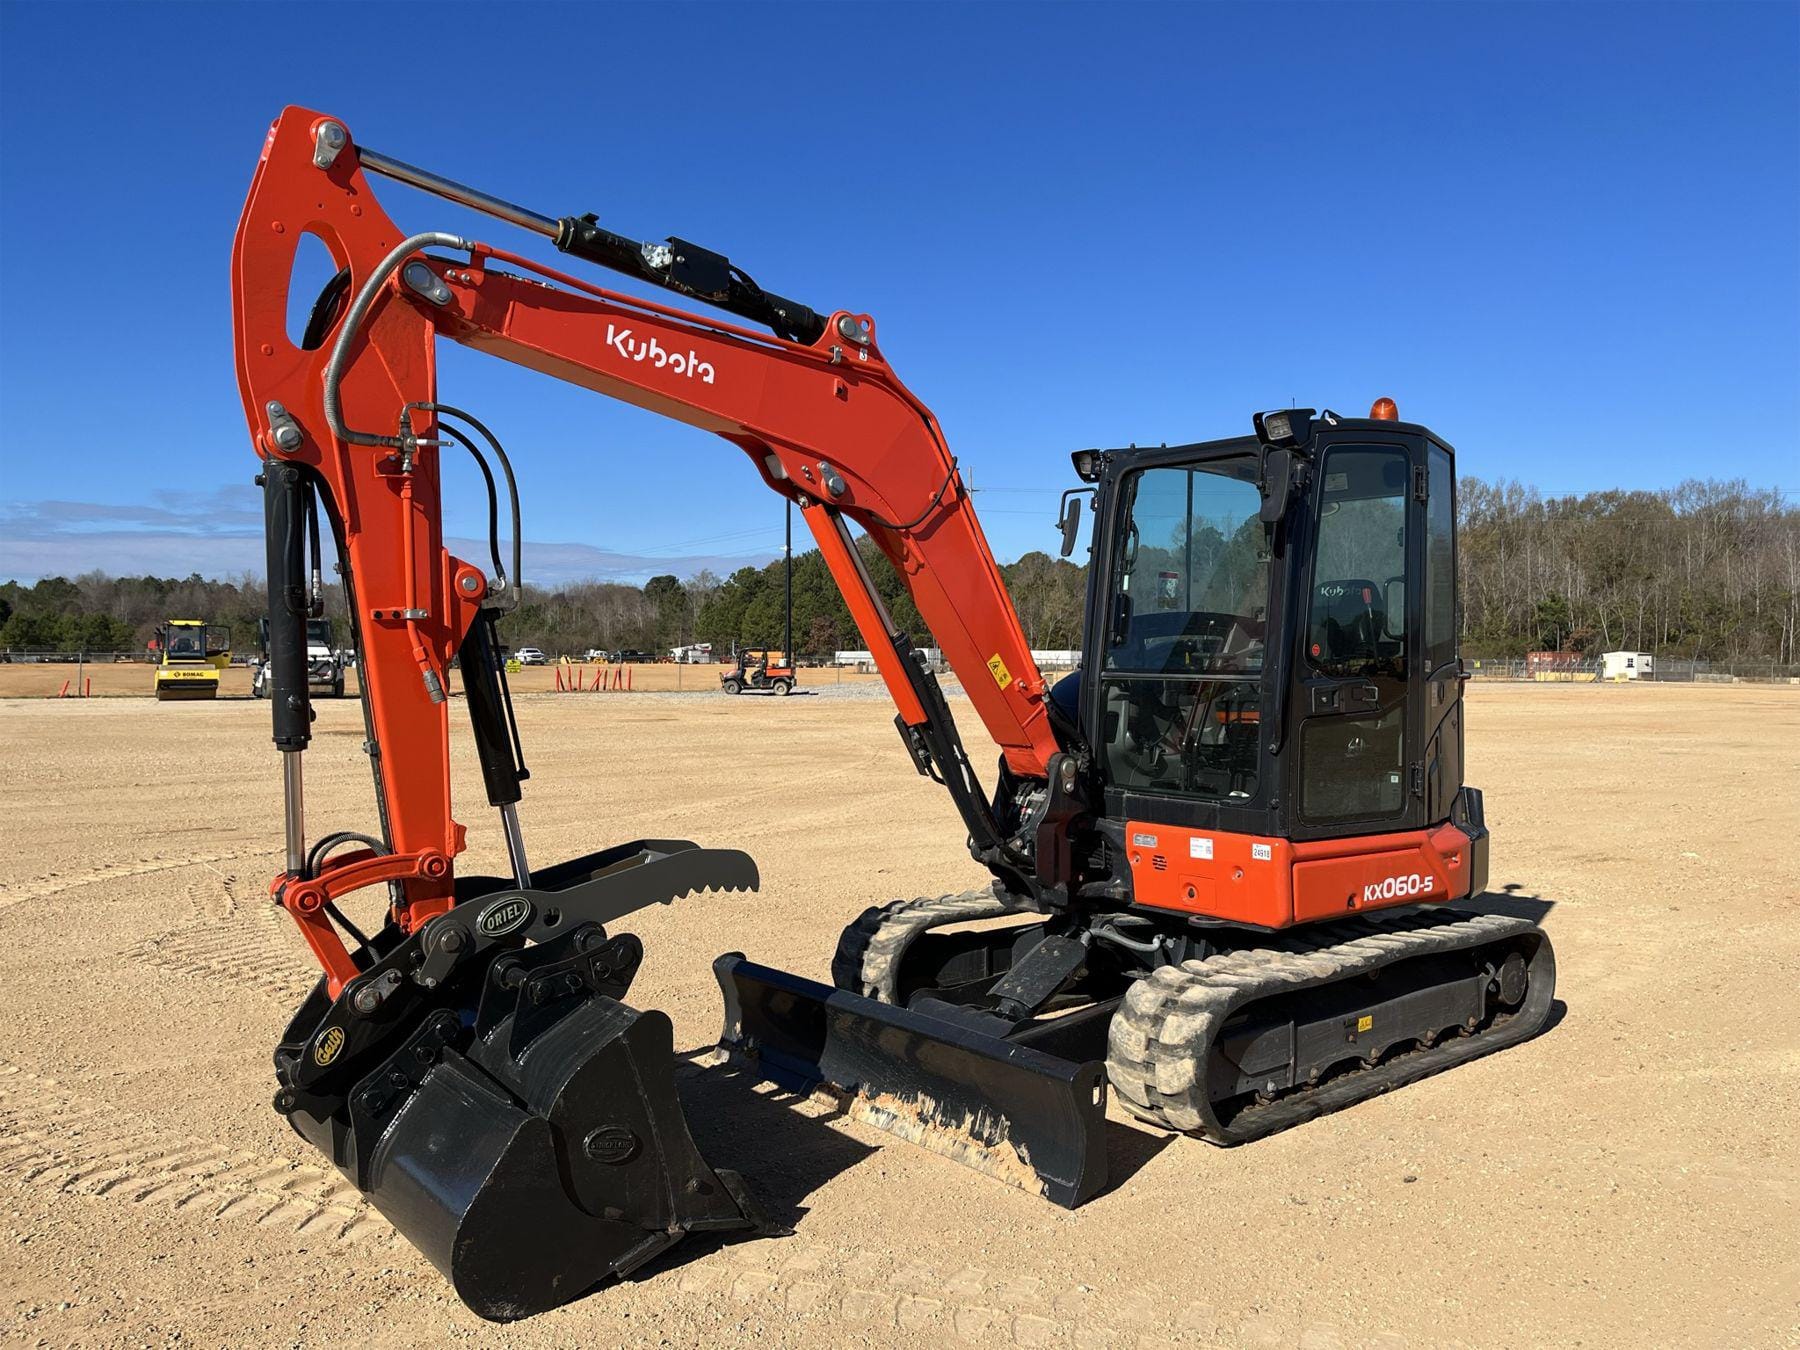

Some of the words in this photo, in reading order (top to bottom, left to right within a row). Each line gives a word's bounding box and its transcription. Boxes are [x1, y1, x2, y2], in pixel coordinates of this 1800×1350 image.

[606, 323, 715, 385] Kubota
[1363, 873, 1434, 902] KX060-5
[487, 904, 521, 930] ORIEL
